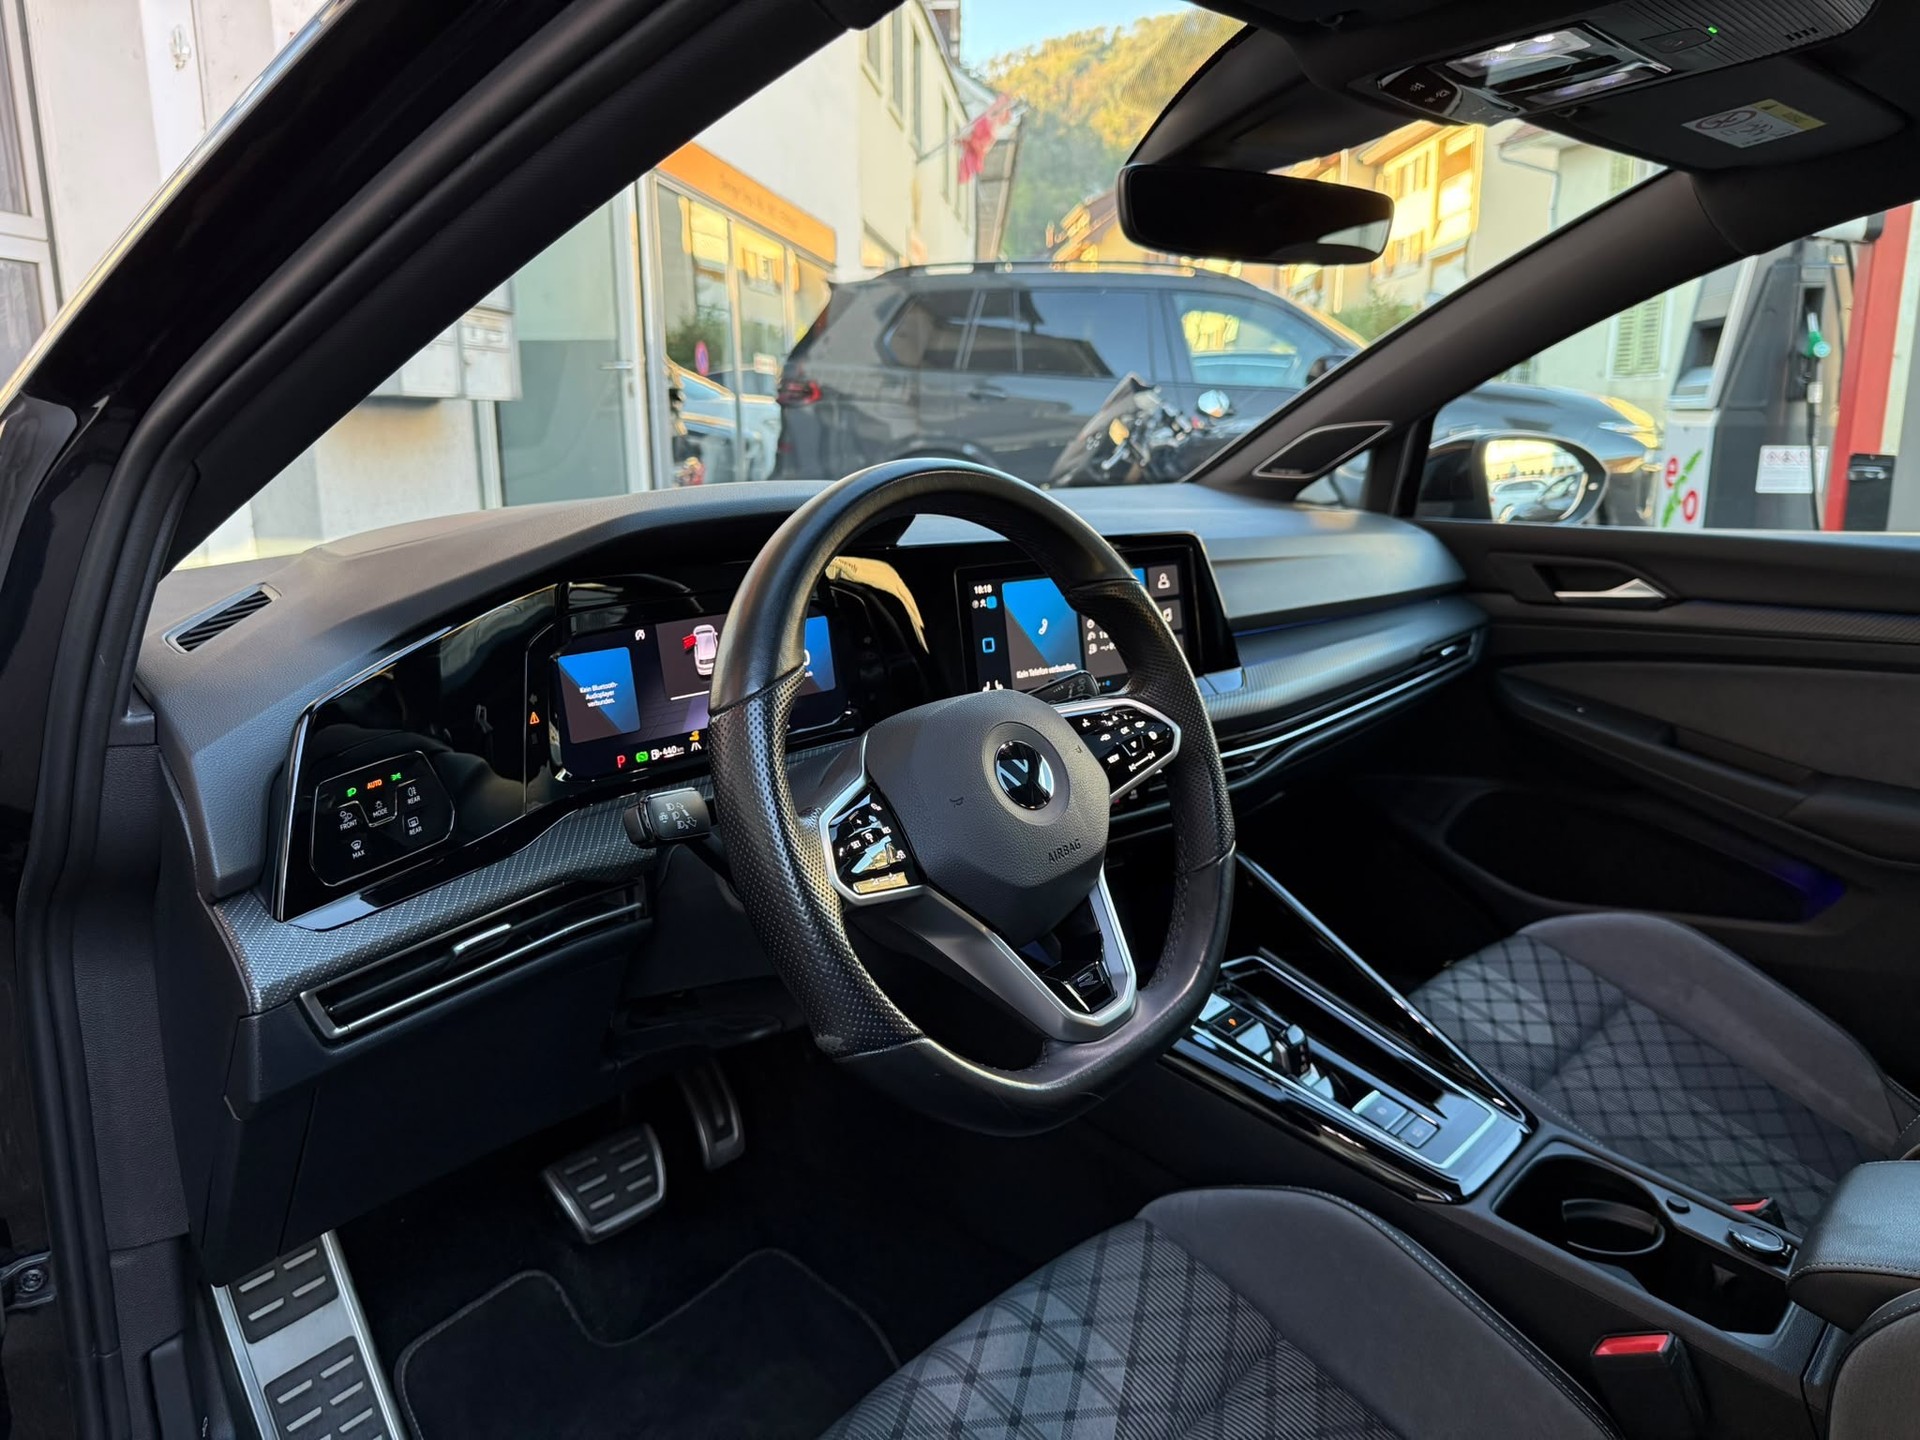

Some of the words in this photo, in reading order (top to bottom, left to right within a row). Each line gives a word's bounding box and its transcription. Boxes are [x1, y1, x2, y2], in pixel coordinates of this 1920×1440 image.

[616, 754, 626, 768] P
[367, 779, 383, 790] AUTO
[407, 796, 421, 805] REAR
[372, 808, 388, 818] MODE
[339, 819, 358, 832] FRONT
[408, 826, 422, 836] REAR
[352, 849, 366, 860] MAX
[1048, 838, 1082, 863] AIRBAG
